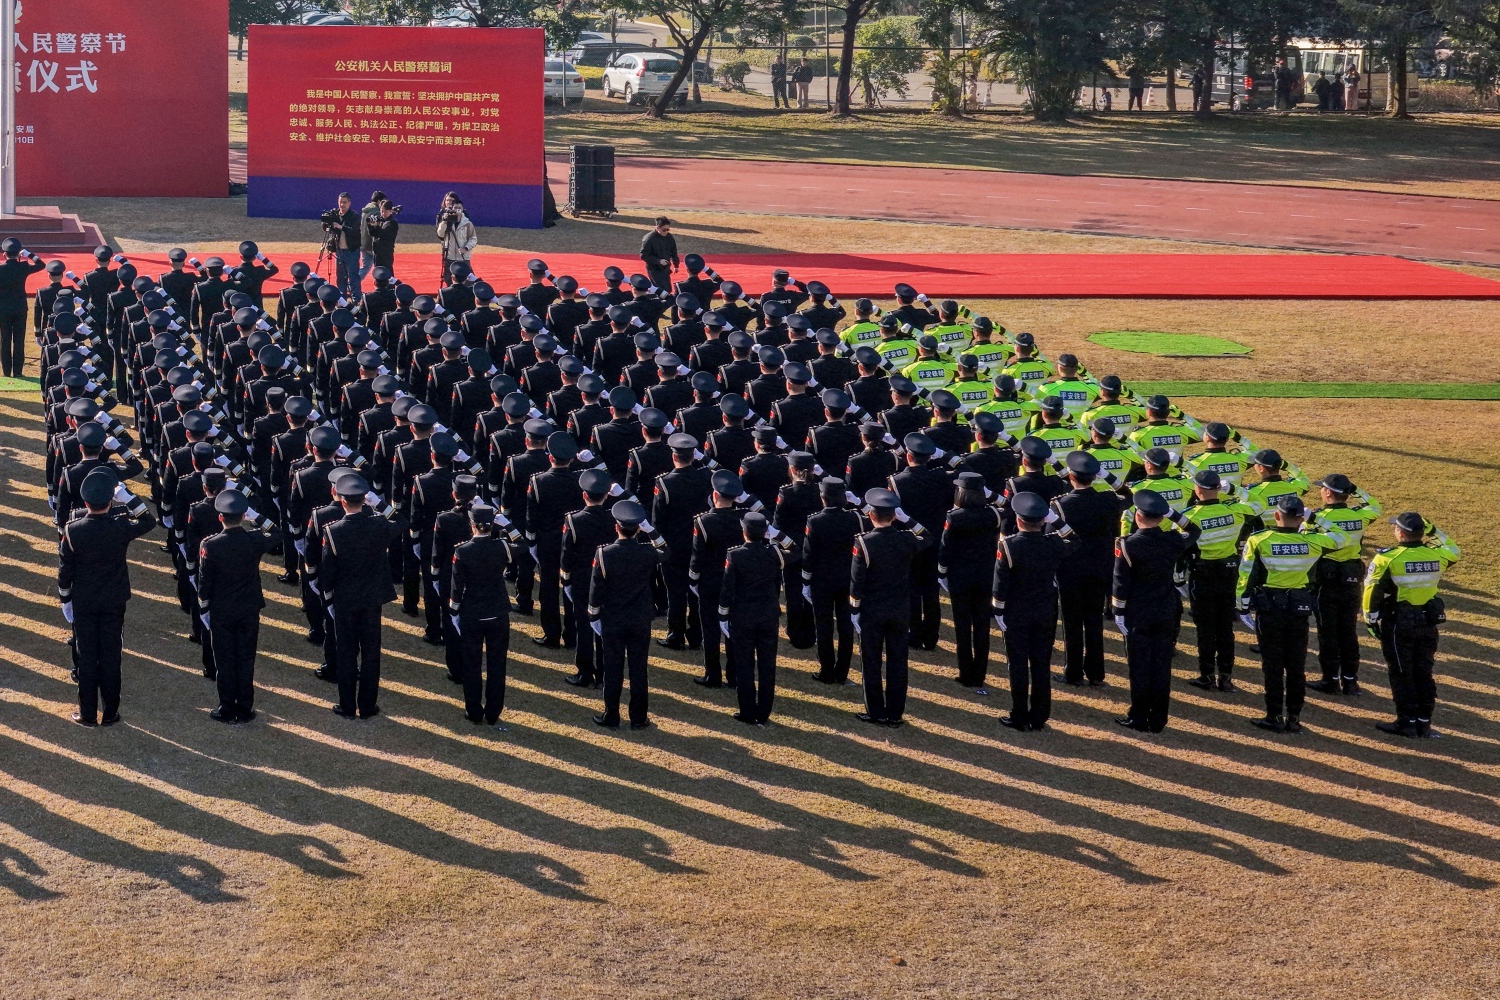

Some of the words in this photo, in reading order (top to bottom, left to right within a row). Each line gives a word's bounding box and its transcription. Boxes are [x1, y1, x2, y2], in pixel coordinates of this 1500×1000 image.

[334, 60, 452, 74] 公安机关人民警察誓词
[1201, 515, 1234, 528] 平安铁骑
[1272, 544, 1309, 555] 平安铁骑
[1406, 561, 1440, 573] 平安铁骑
